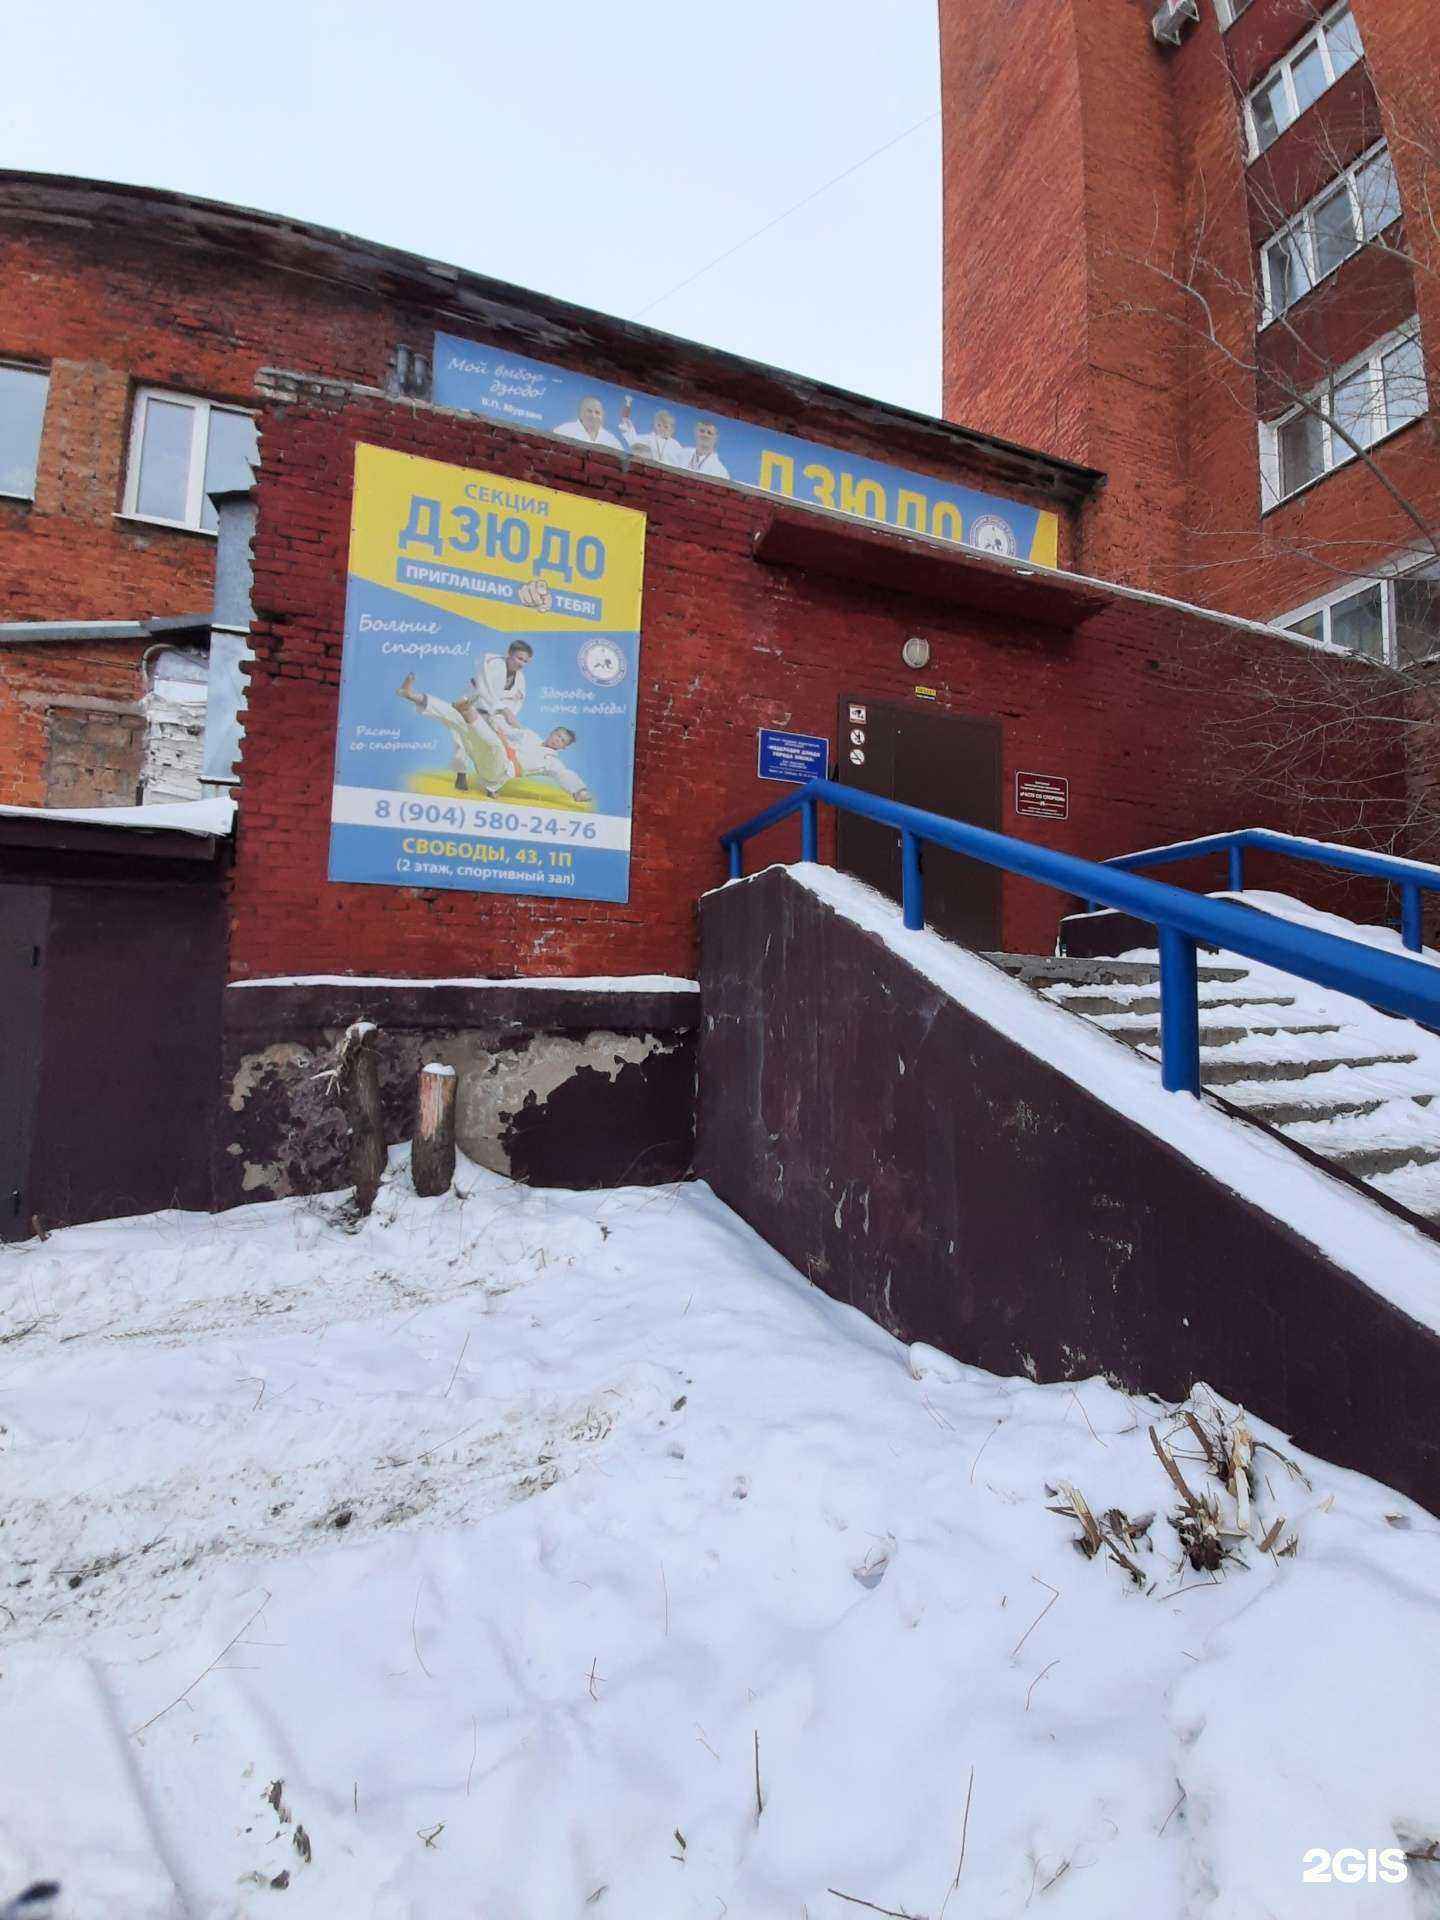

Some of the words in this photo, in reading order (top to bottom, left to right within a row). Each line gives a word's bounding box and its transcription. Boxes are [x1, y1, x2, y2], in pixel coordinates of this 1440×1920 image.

[447, 357, 489, 375] Мой
[463, 483, 549, 517] СЕКЦИЯ
[398, 494, 606, 583] ДЗЮДО
[405, 564, 513, 598] ПРИГЛАШАЮ
[555, 594, 596, 616] ТЕБЯ!
[359, 613, 441, 634] Больше
[381, 640, 472, 660] спорта!
[374, 800, 391, 819] 8
[399, 801, 467, 829] (904)
[473, 809, 597, 840] 580-24-76
[402, 837, 511, 864] СВОБОДЫ,
[515, 849, 544, 866] 43,
[548, 851, 573, 868] 1П
[396, 857, 411, 873] (2
[413, 861, 453, 877] этаж,
[456, 864, 545, 882] спортивный
[547, 872, 576, 886] зал)
